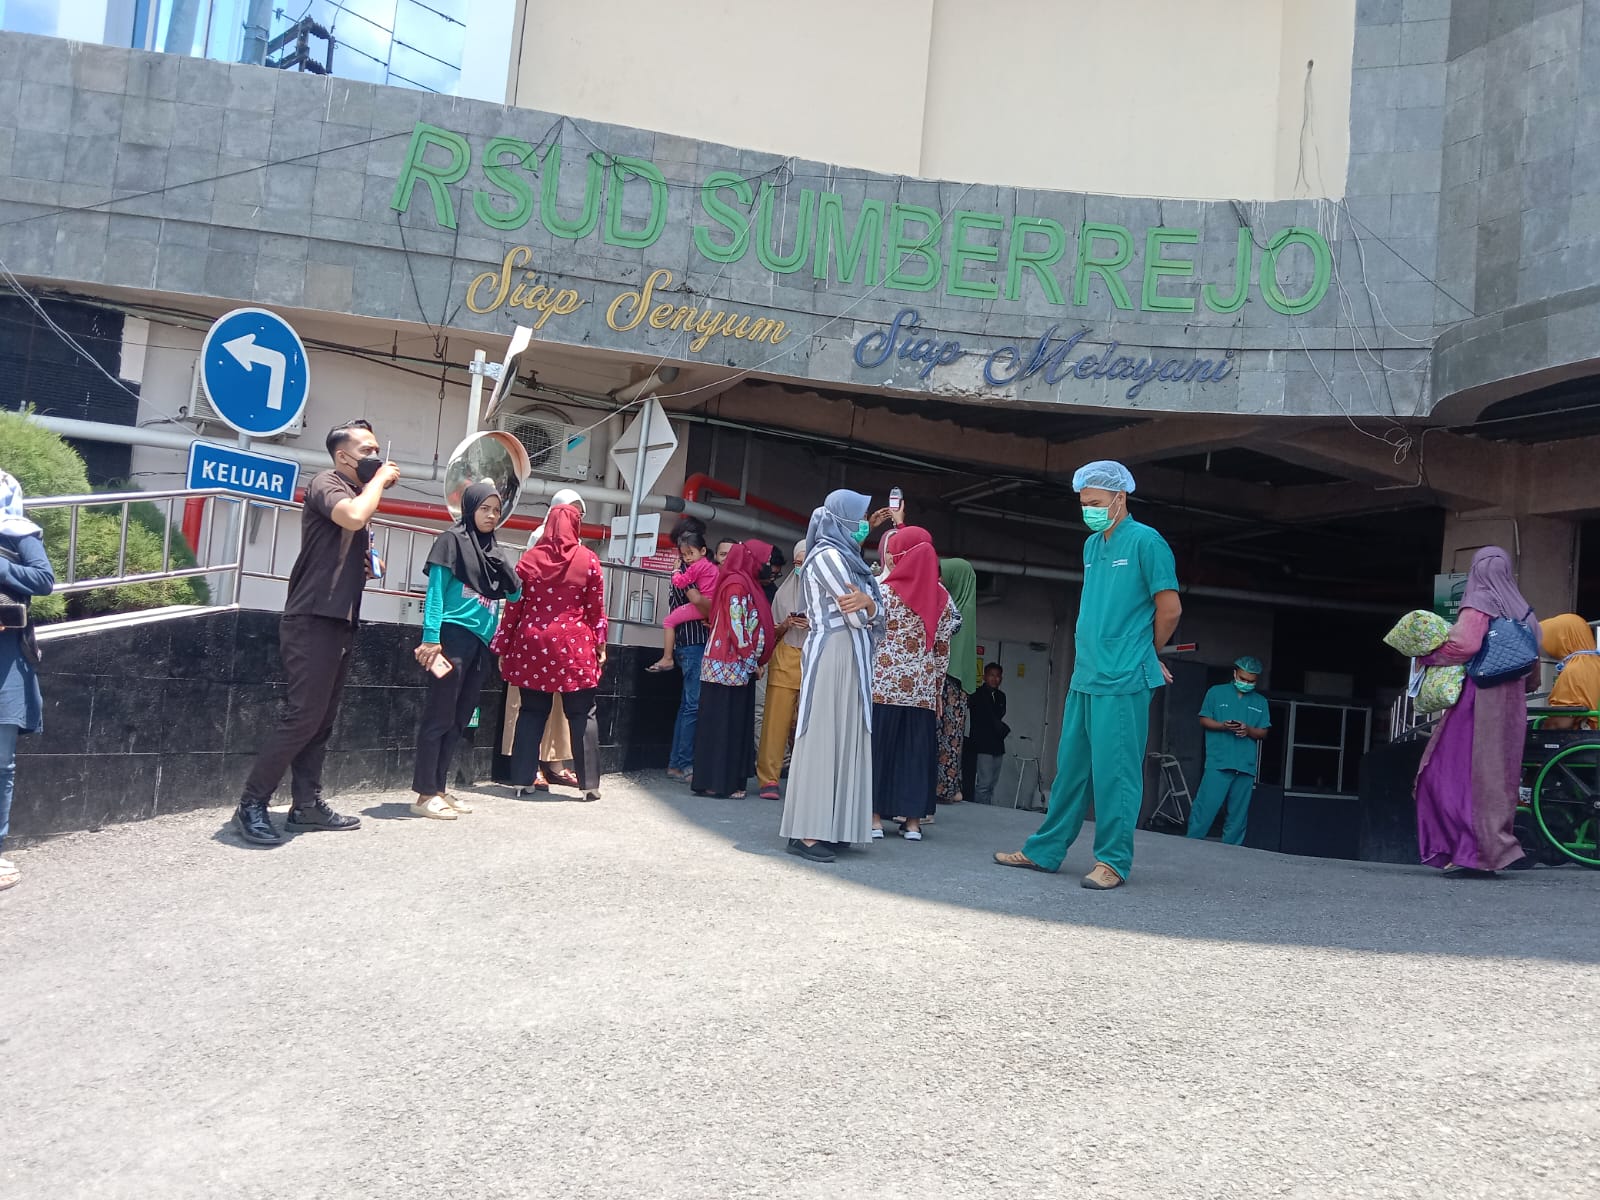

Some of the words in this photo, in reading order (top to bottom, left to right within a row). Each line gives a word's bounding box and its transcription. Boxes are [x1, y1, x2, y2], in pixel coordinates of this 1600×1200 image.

[391, 120, 669, 249] RSUD
[694, 170, 1332, 315] SUMBERREJO
[465, 245, 584, 330] Siap
[606, 269, 792, 353] Senyum
[854, 308, 964, 378] Siap
[984, 324, 1235, 399] Melayani
[201, 459, 284, 493] KELUAR
